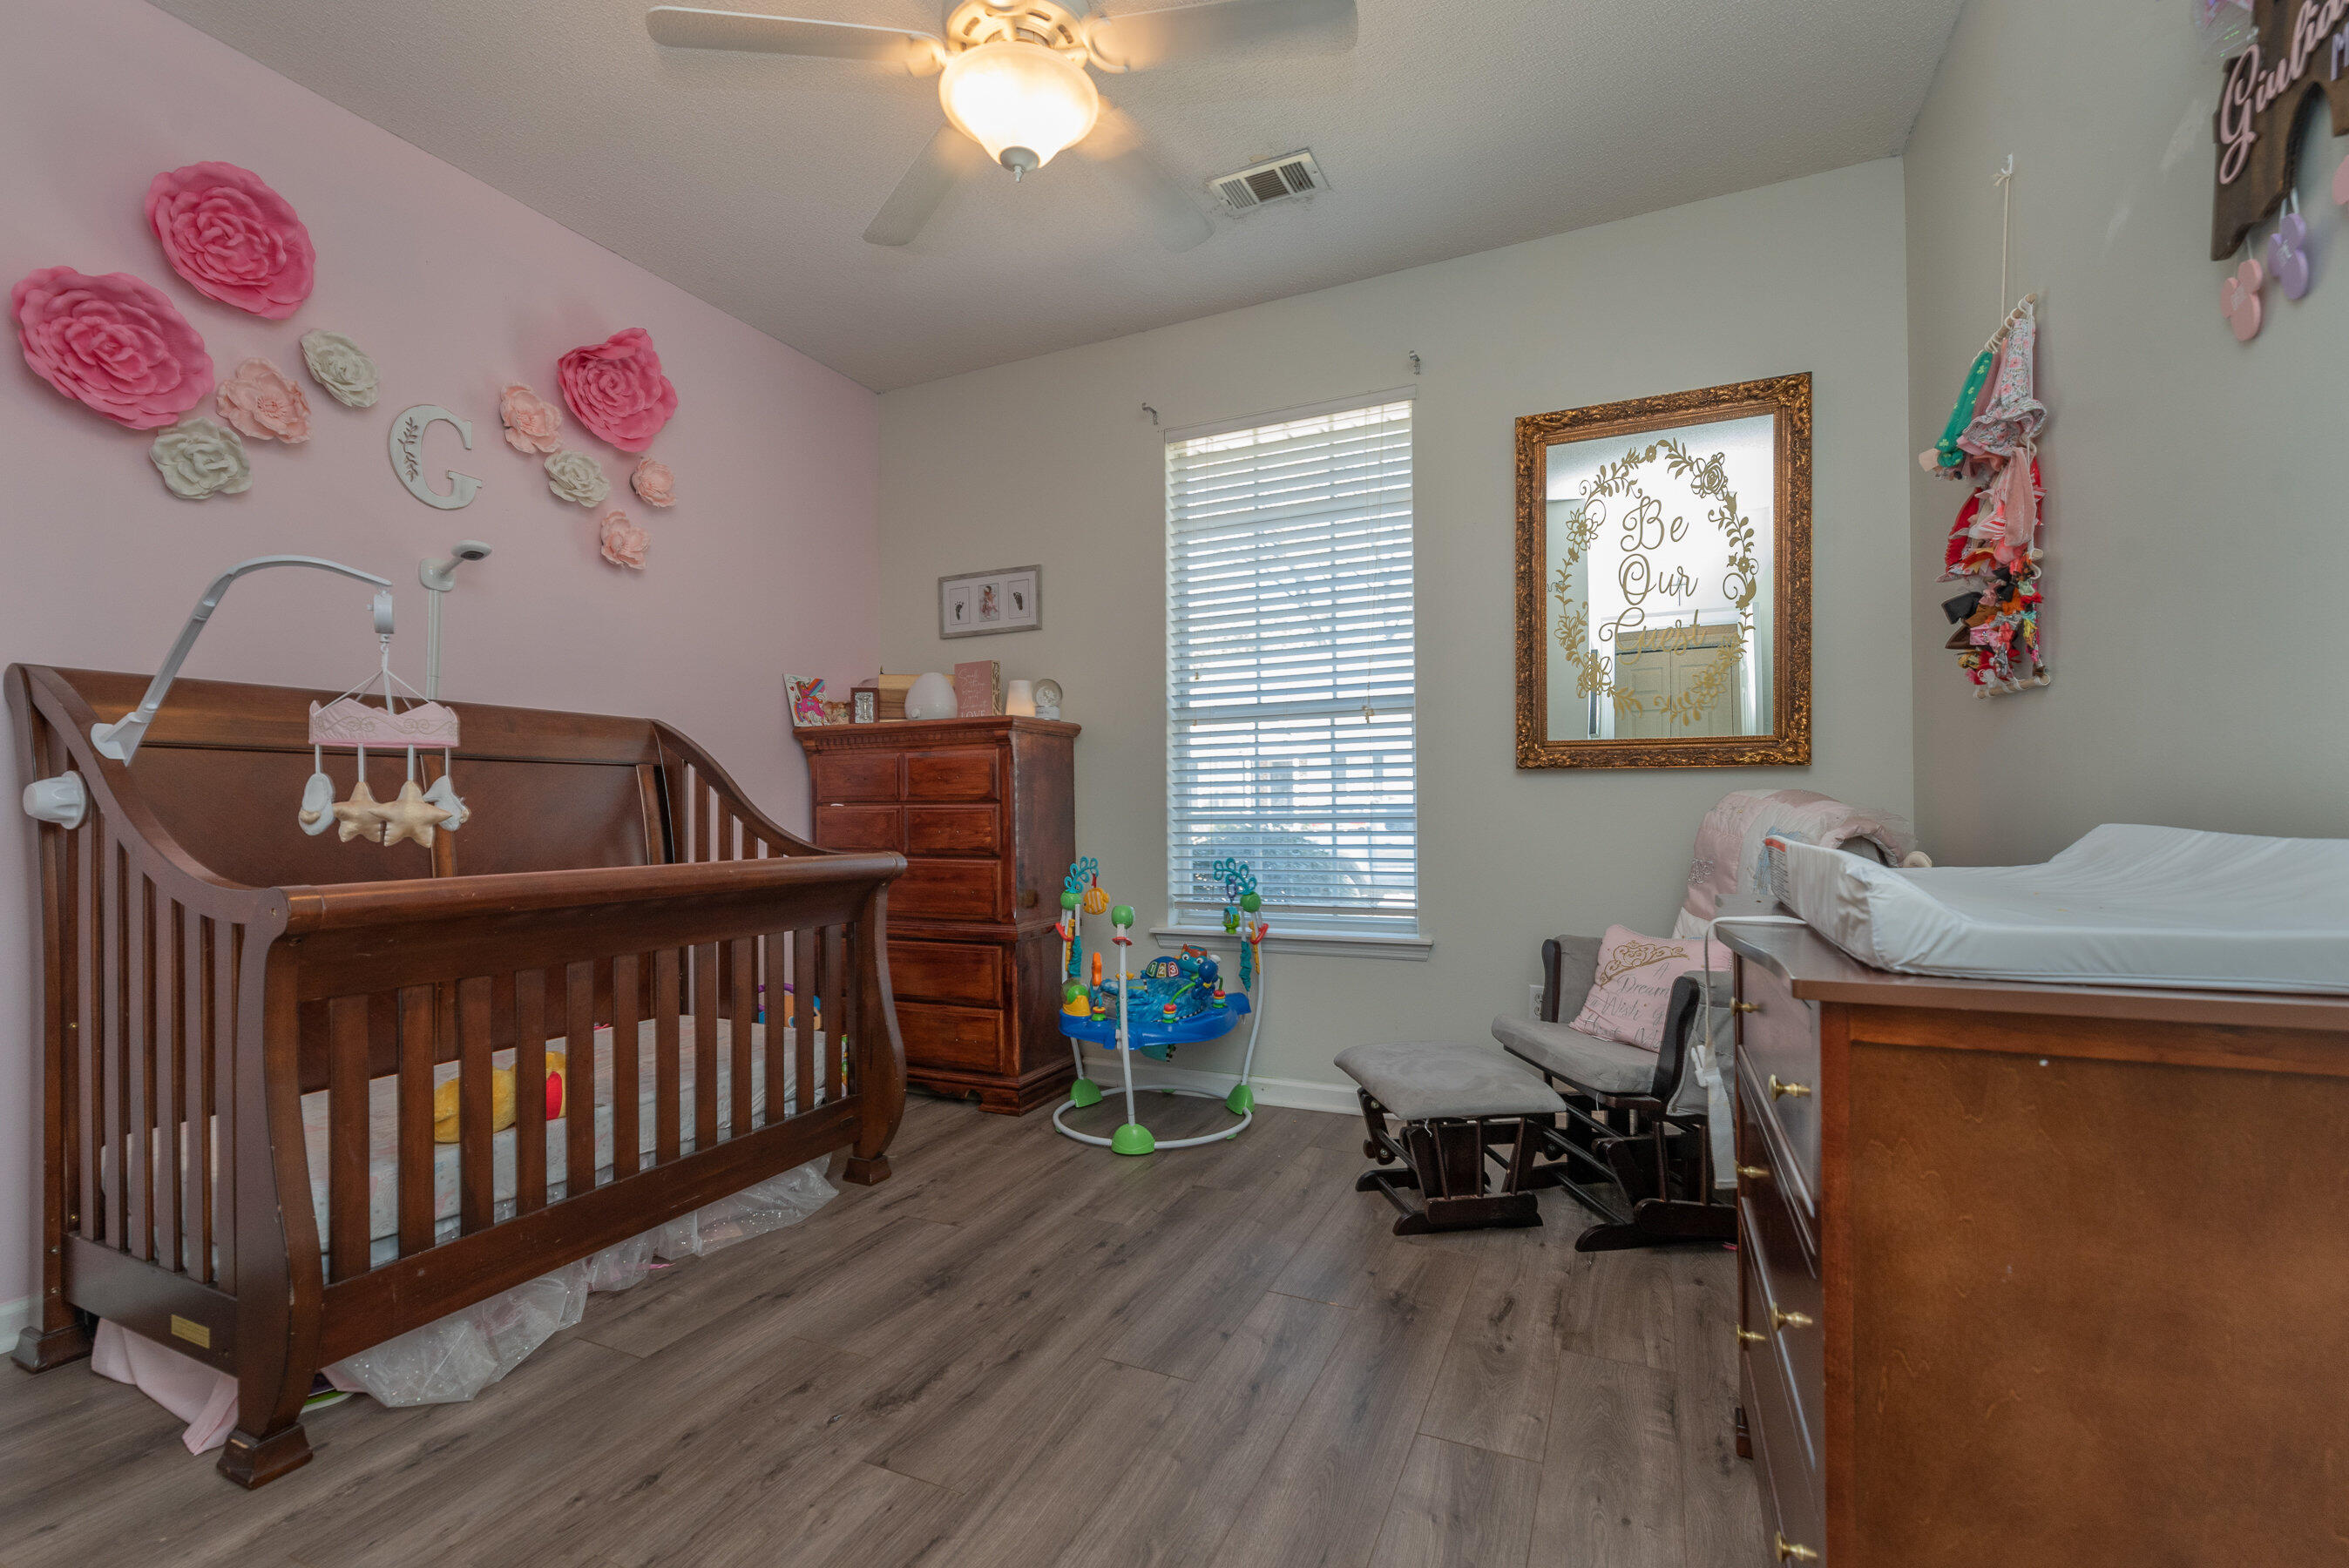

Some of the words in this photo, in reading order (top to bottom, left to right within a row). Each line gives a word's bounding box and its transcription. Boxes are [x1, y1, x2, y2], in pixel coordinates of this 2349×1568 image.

[387, 403, 483, 511] G
[1621, 496, 1689, 551] Be
[1619, 553, 1698, 605] Our
[1599, 606, 1707, 666] Guest
[1653, 962, 1671, 981] A
[1601, 992, 1643, 1021] Wish
